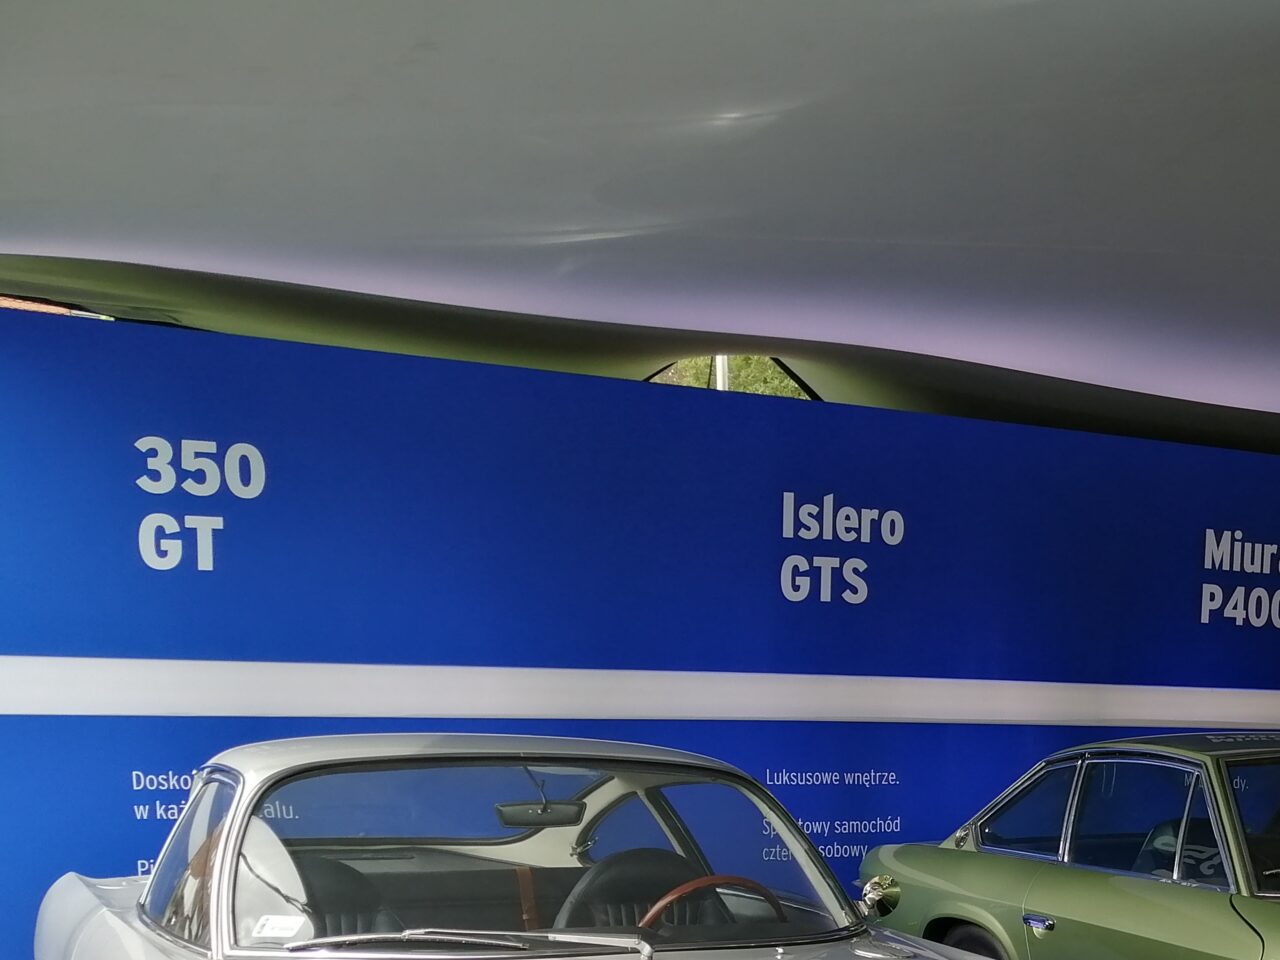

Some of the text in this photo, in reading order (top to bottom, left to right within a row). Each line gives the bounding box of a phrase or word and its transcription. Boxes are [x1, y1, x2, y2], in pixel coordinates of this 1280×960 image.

[135, 436, 265, 498] 350
[782, 491, 904, 545] Islero
[138, 513, 224, 571] GT
[780, 555, 868, 604] GTS
[132, 770, 195, 790] Dosko
[766, 768, 900, 788] Luksusowe wnętrze.
[134, 806, 149, 820] w
[834, 816, 901, 834] samochód
